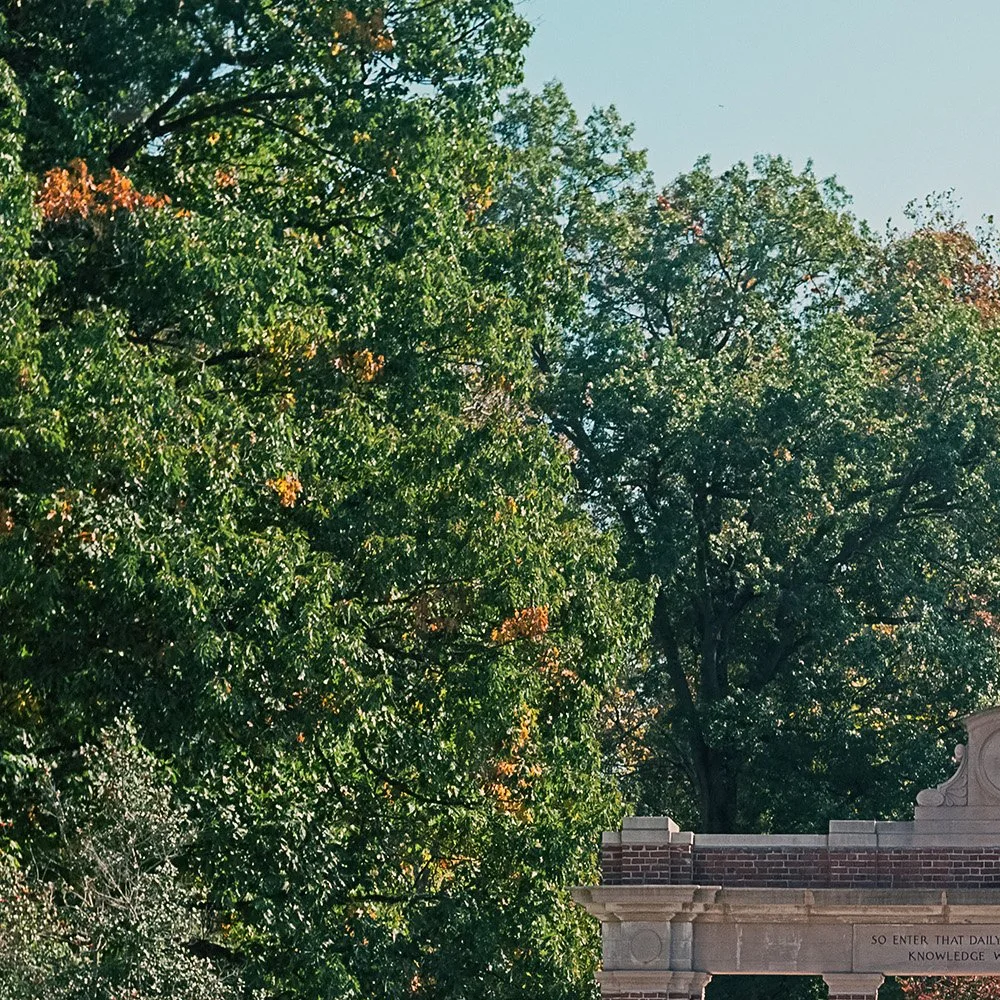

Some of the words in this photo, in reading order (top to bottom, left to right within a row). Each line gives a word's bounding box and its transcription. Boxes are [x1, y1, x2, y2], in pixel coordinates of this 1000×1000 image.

[871, 934, 887, 945] SO
[893, 934, 929, 945] ENTER
[935, 934, 964, 945] THAT
[908, 951, 985, 961] KNOWLEDGE
